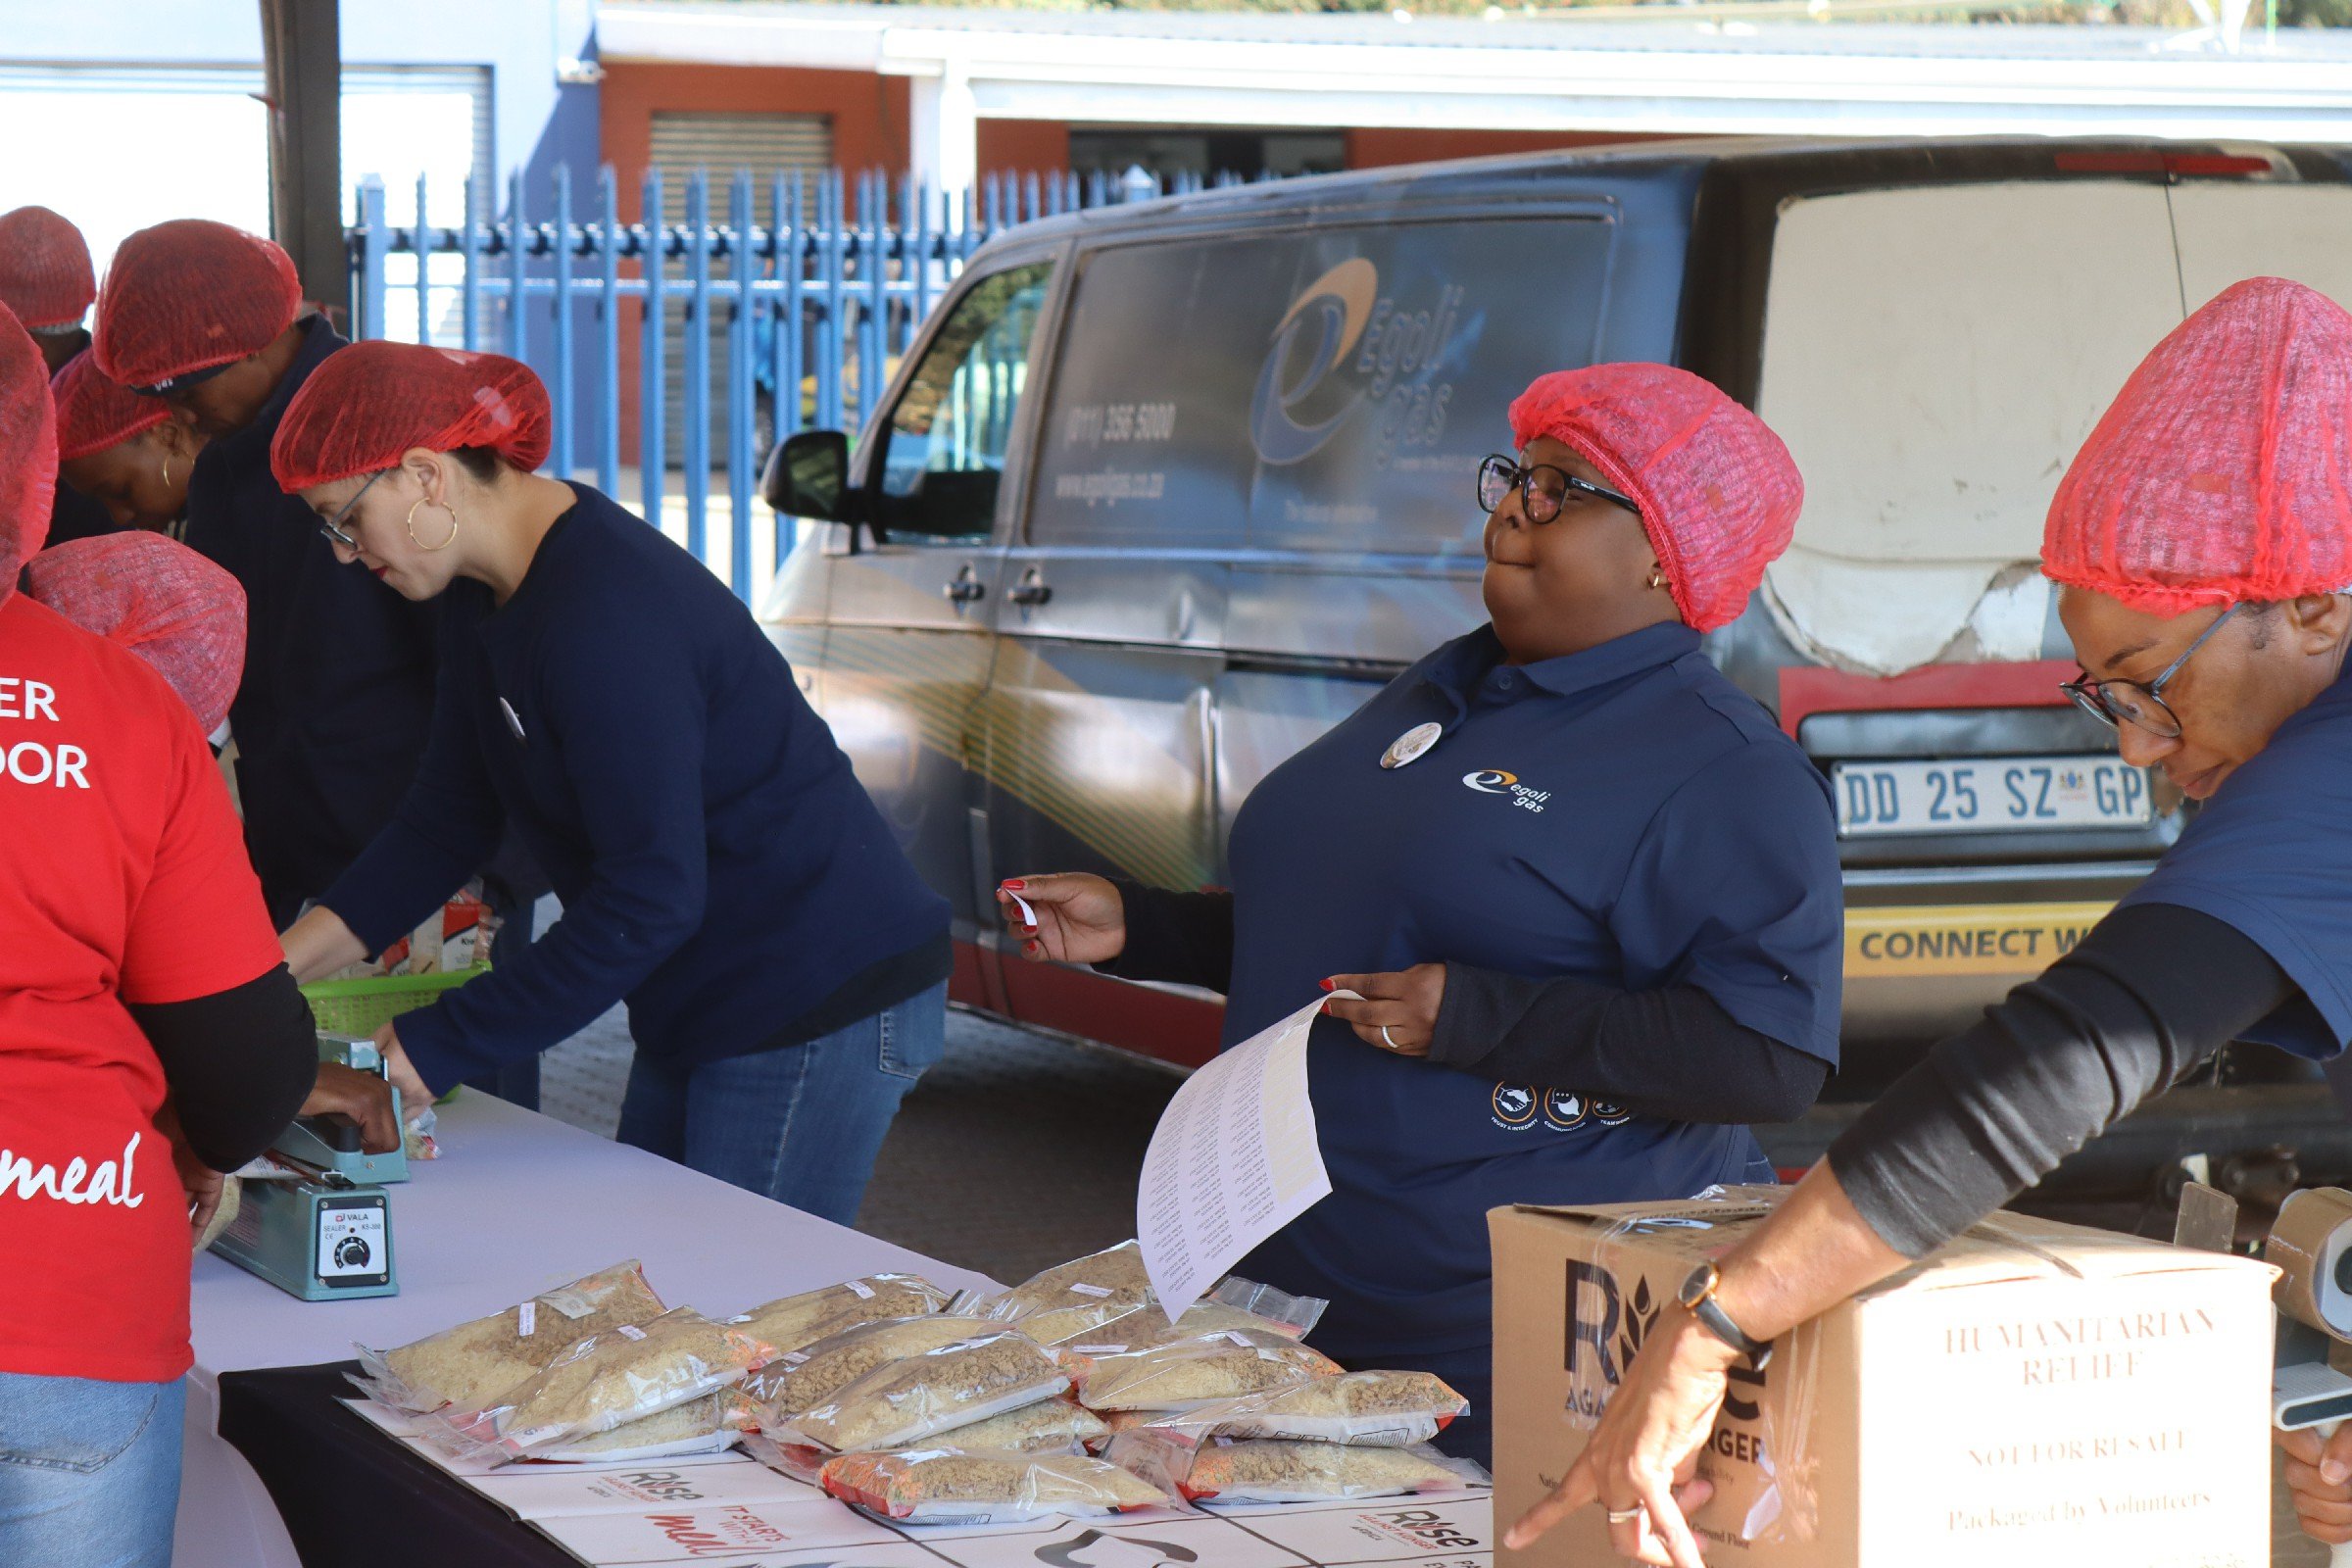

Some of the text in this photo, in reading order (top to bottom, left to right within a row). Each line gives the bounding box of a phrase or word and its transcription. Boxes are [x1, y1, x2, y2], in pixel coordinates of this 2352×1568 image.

[0, 741, 91, 789] OR
[1510, 784, 1551, 803] egoli
[1513, 796, 1544, 813] gas
[1846, 765, 2141, 823] DD 25 SZ GP
[1860, 927, 2090, 959] CONNECT W
[0, 1131, 144, 1208] meal
[1946, 1308, 2214, 1353] HUMANITARIAN
[2023, 1350, 2144, 1386] RELIEF
